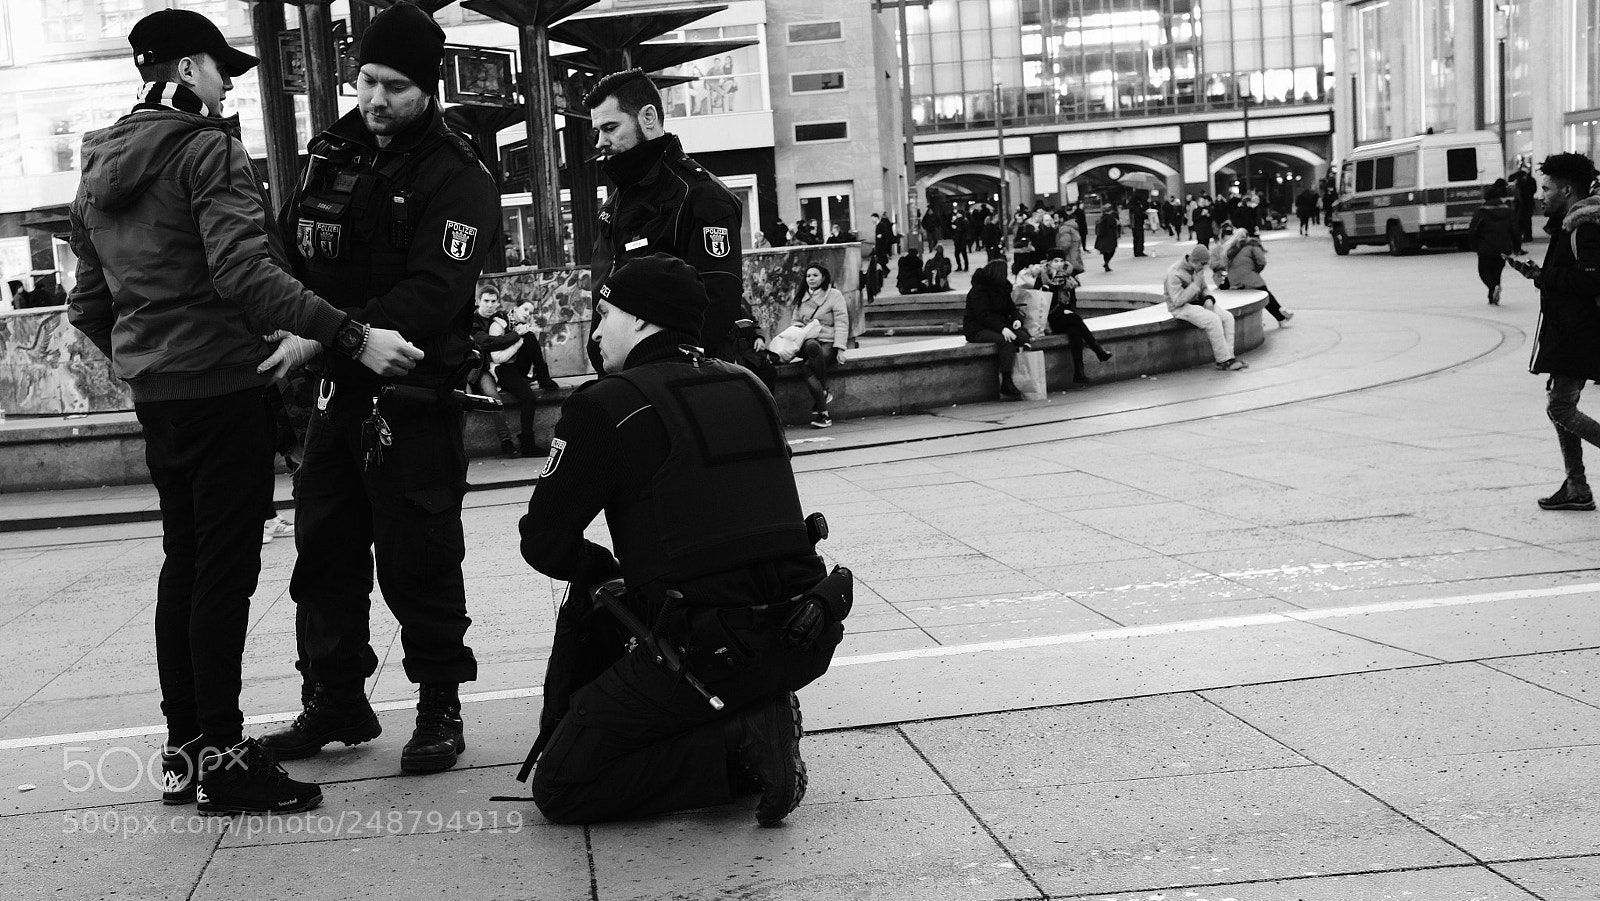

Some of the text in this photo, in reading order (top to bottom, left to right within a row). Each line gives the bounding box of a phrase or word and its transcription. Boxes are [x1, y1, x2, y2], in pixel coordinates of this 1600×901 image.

[598, 212, 611, 224] POL
[318, 224, 339, 233] POLIZEI
[448, 222, 475, 236] POLIZEI
[705, 228, 727, 236] POLIZEI
